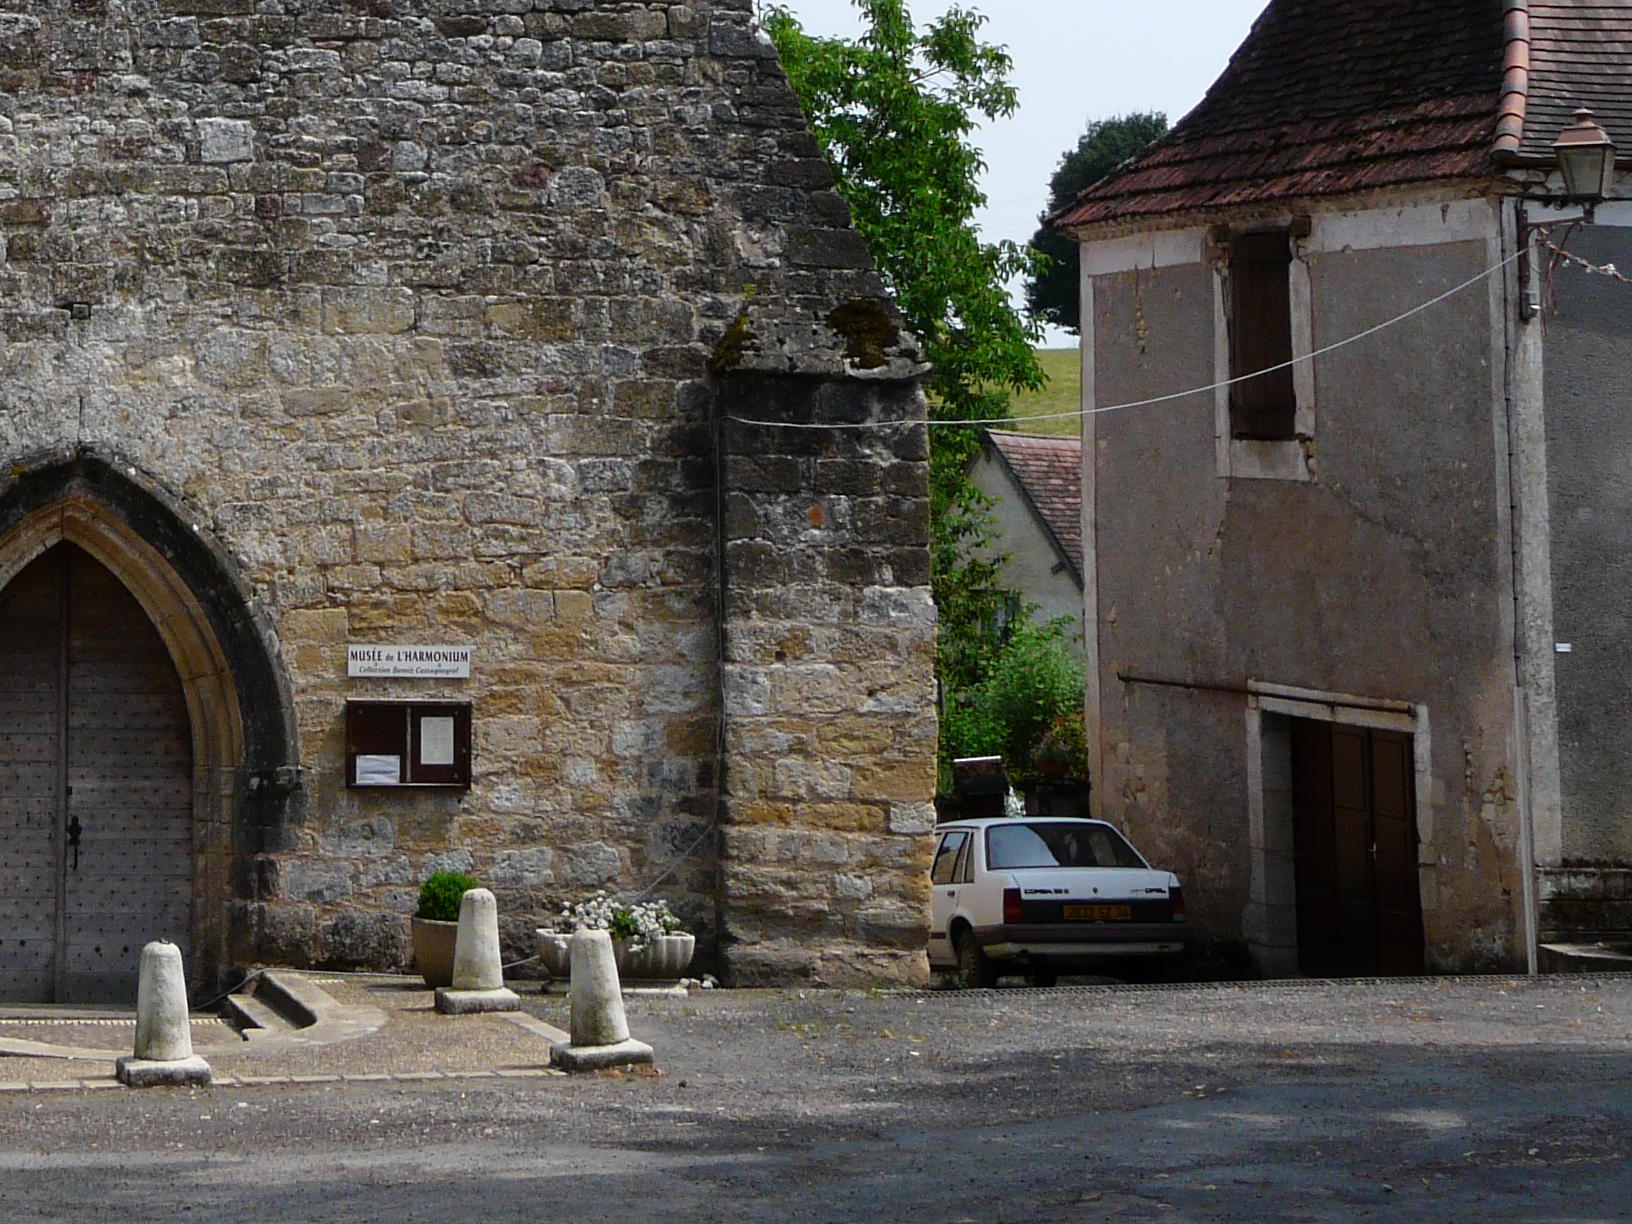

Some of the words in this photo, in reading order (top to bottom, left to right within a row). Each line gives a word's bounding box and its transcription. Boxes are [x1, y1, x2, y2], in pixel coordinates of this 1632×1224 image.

[350, 646, 382, 662] MUSÉE
[385, 652, 394, 662] de
[397, 650, 468, 663] L'HARMONIUM
